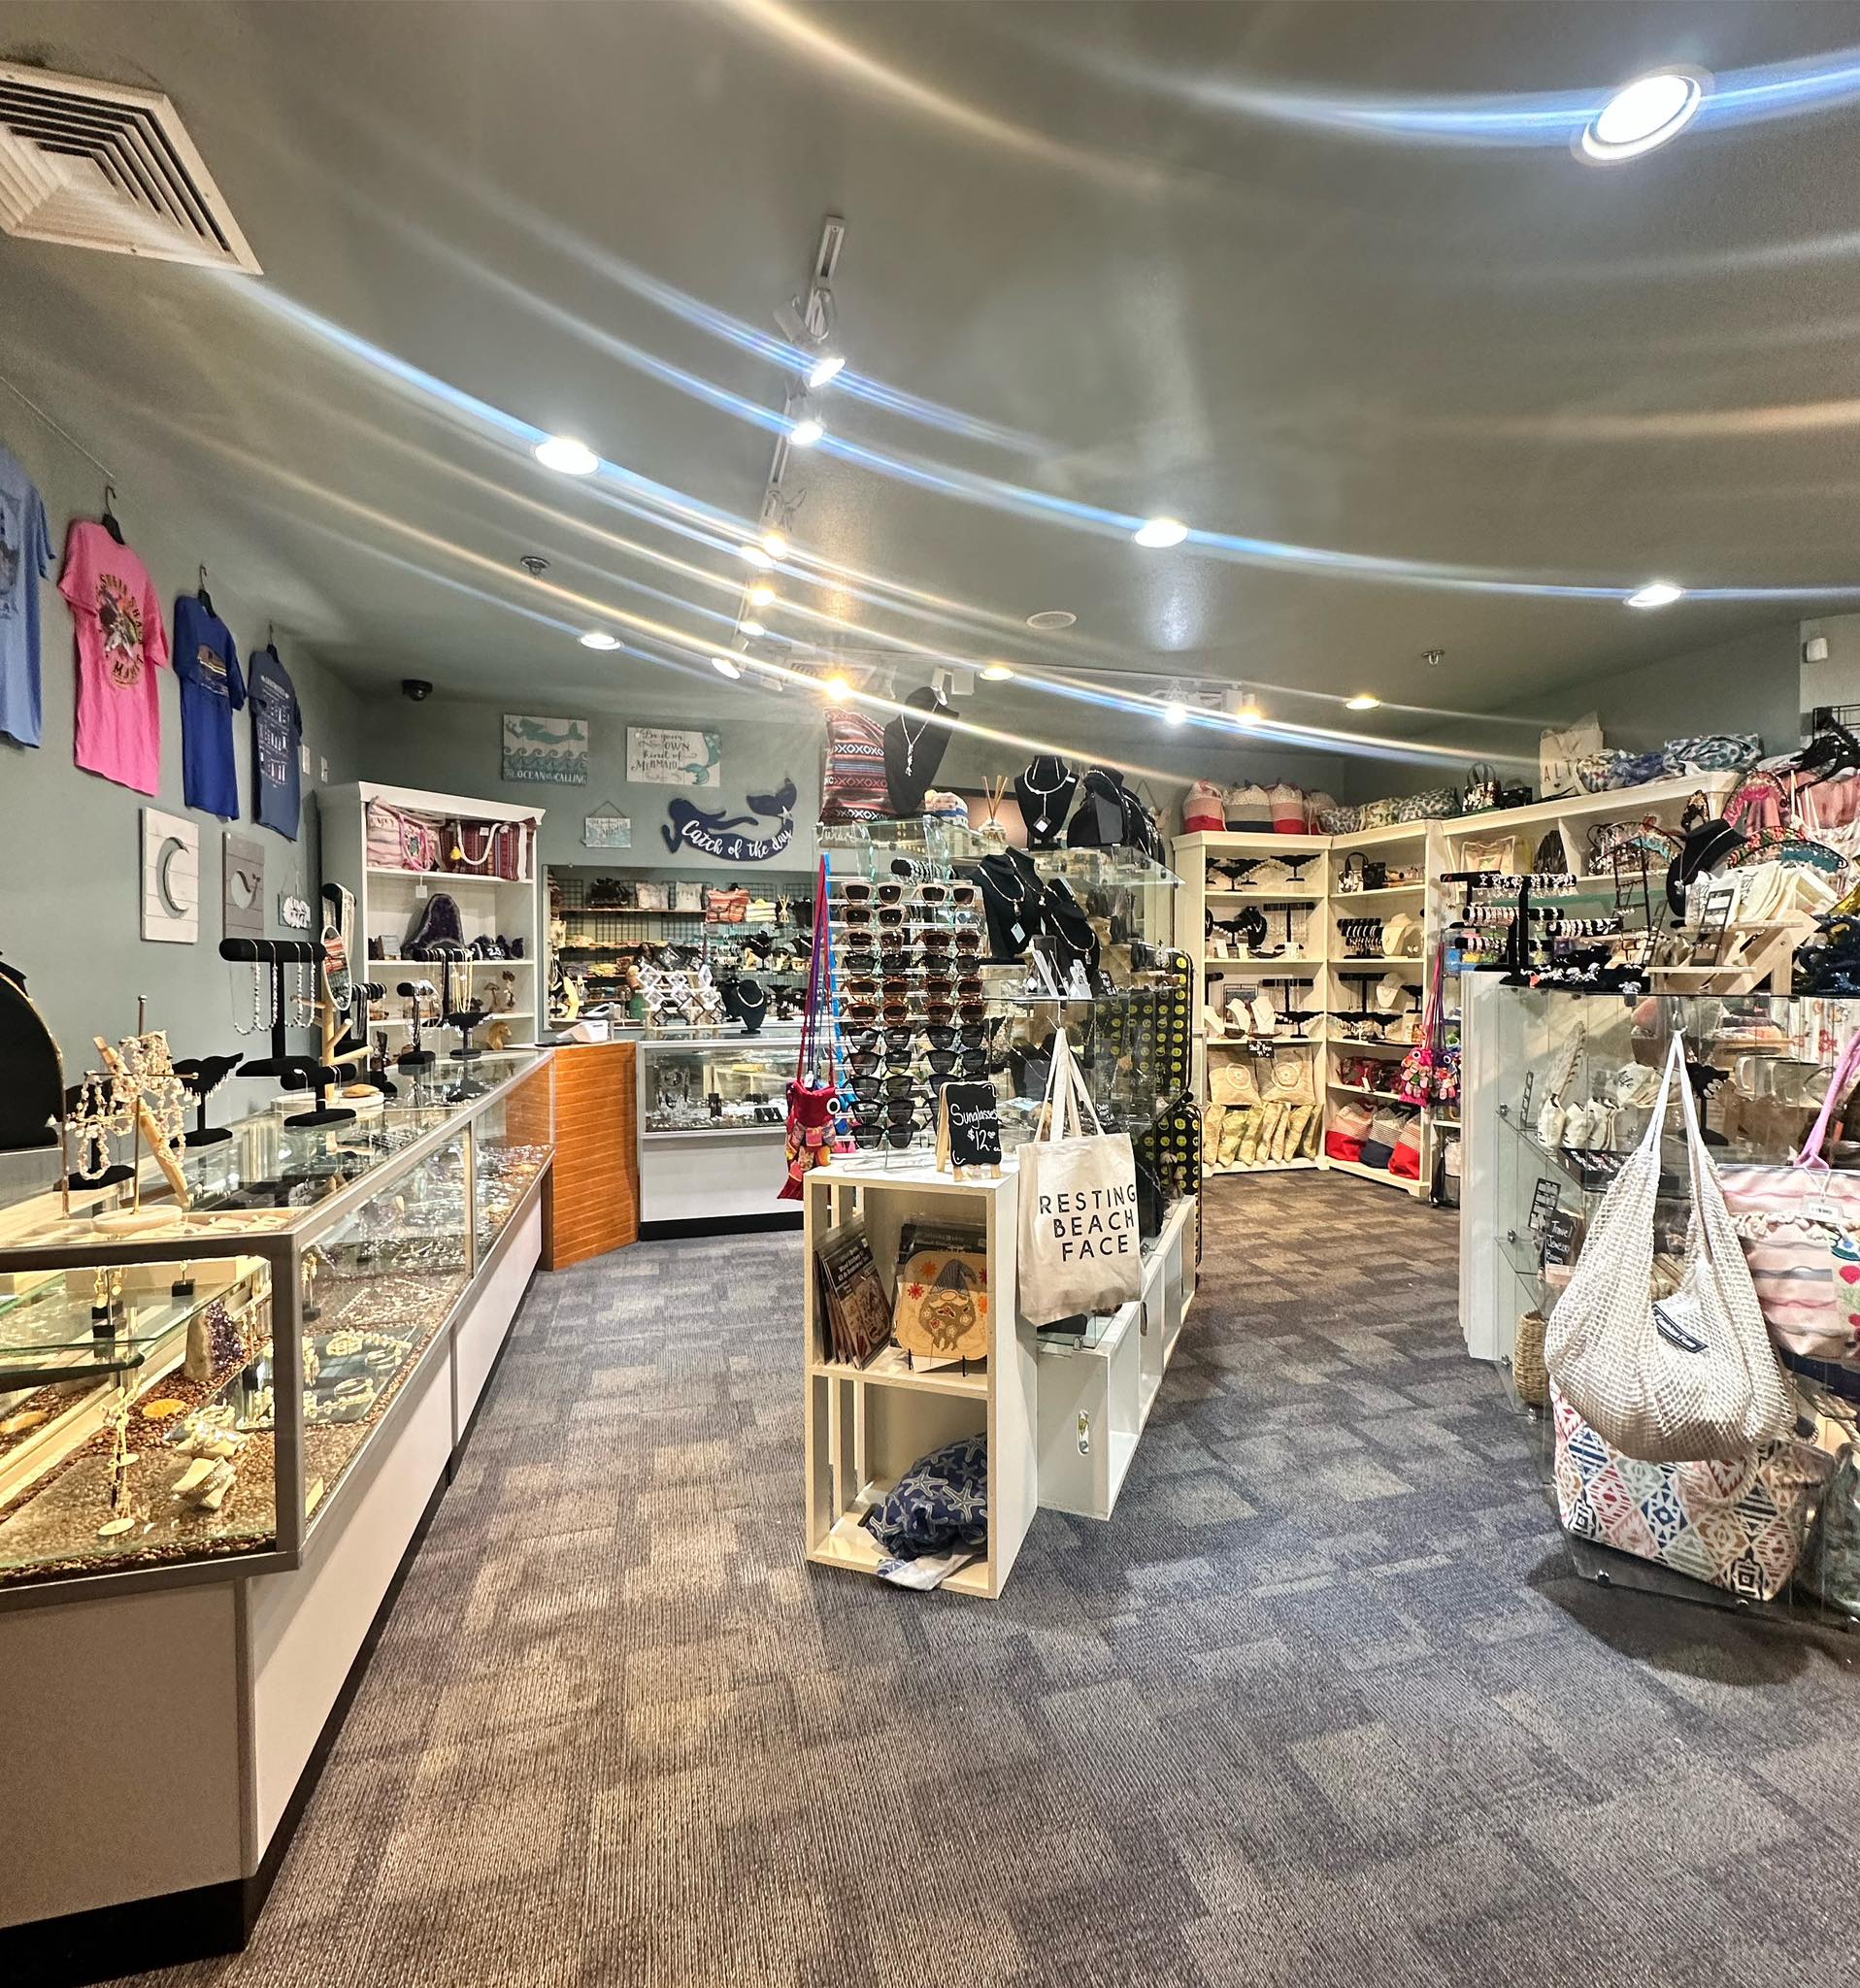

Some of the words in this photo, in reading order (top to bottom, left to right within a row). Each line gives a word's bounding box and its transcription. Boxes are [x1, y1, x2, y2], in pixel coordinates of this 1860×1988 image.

[664, 742, 690, 752] OWN
[516, 770, 546, 780] OCEAN
[554, 773, 587, 784] CALLING
[681, 820, 723, 854] Catch
[727, 839, 743, 859] of
[747, 841, 770, 859] the
[772, 829, 793, 851] day
[950, 1104, 998, 1130] Sunglasses
[1039, 1183, 1136, 1214] RESTING
[1053, 1209, 1135, 1239] BEACH
[1062, 1234, 1128, 1262] FACE
